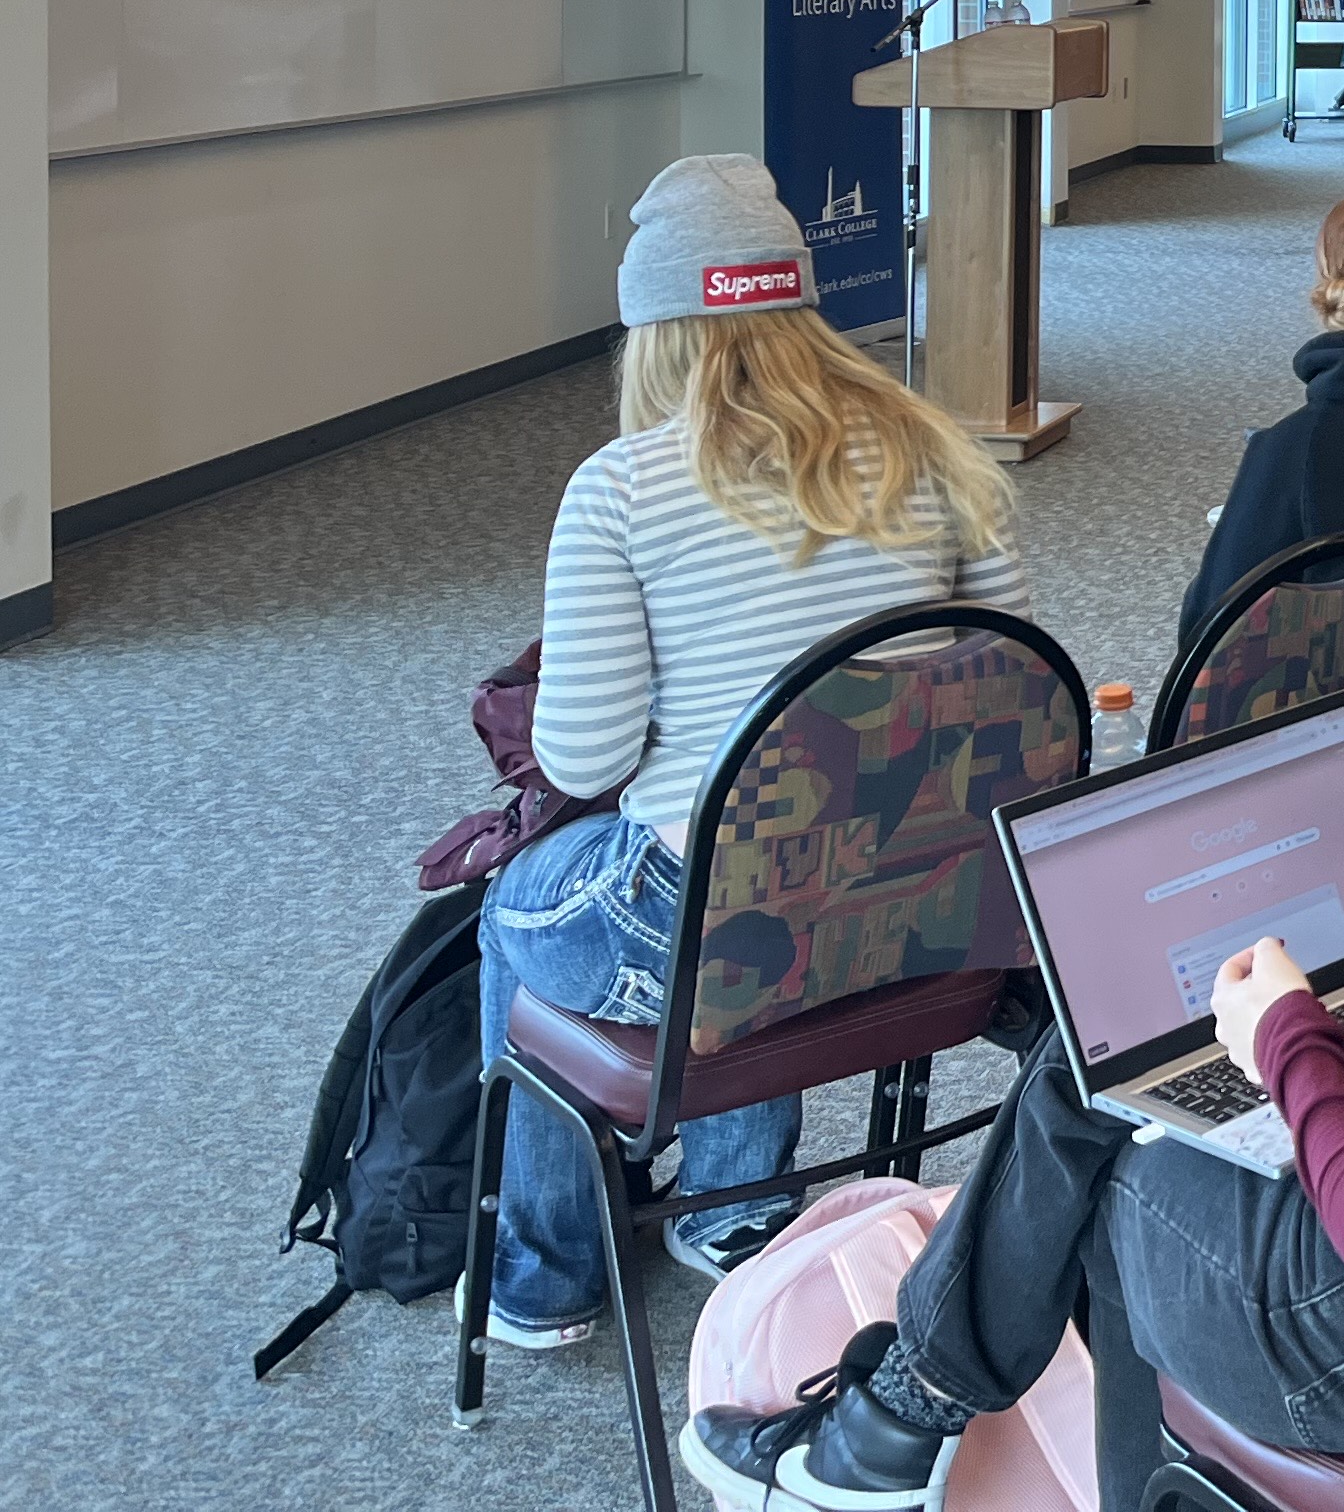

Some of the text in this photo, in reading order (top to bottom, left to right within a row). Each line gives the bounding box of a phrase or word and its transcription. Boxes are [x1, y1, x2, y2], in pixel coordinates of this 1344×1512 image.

[805, 227, 837, 241] CLARK
[838, 219, 878, 234] COLLEGE
[707, 271, 796, 300] Supreme
[1190, 817, 1259, 852] Google
